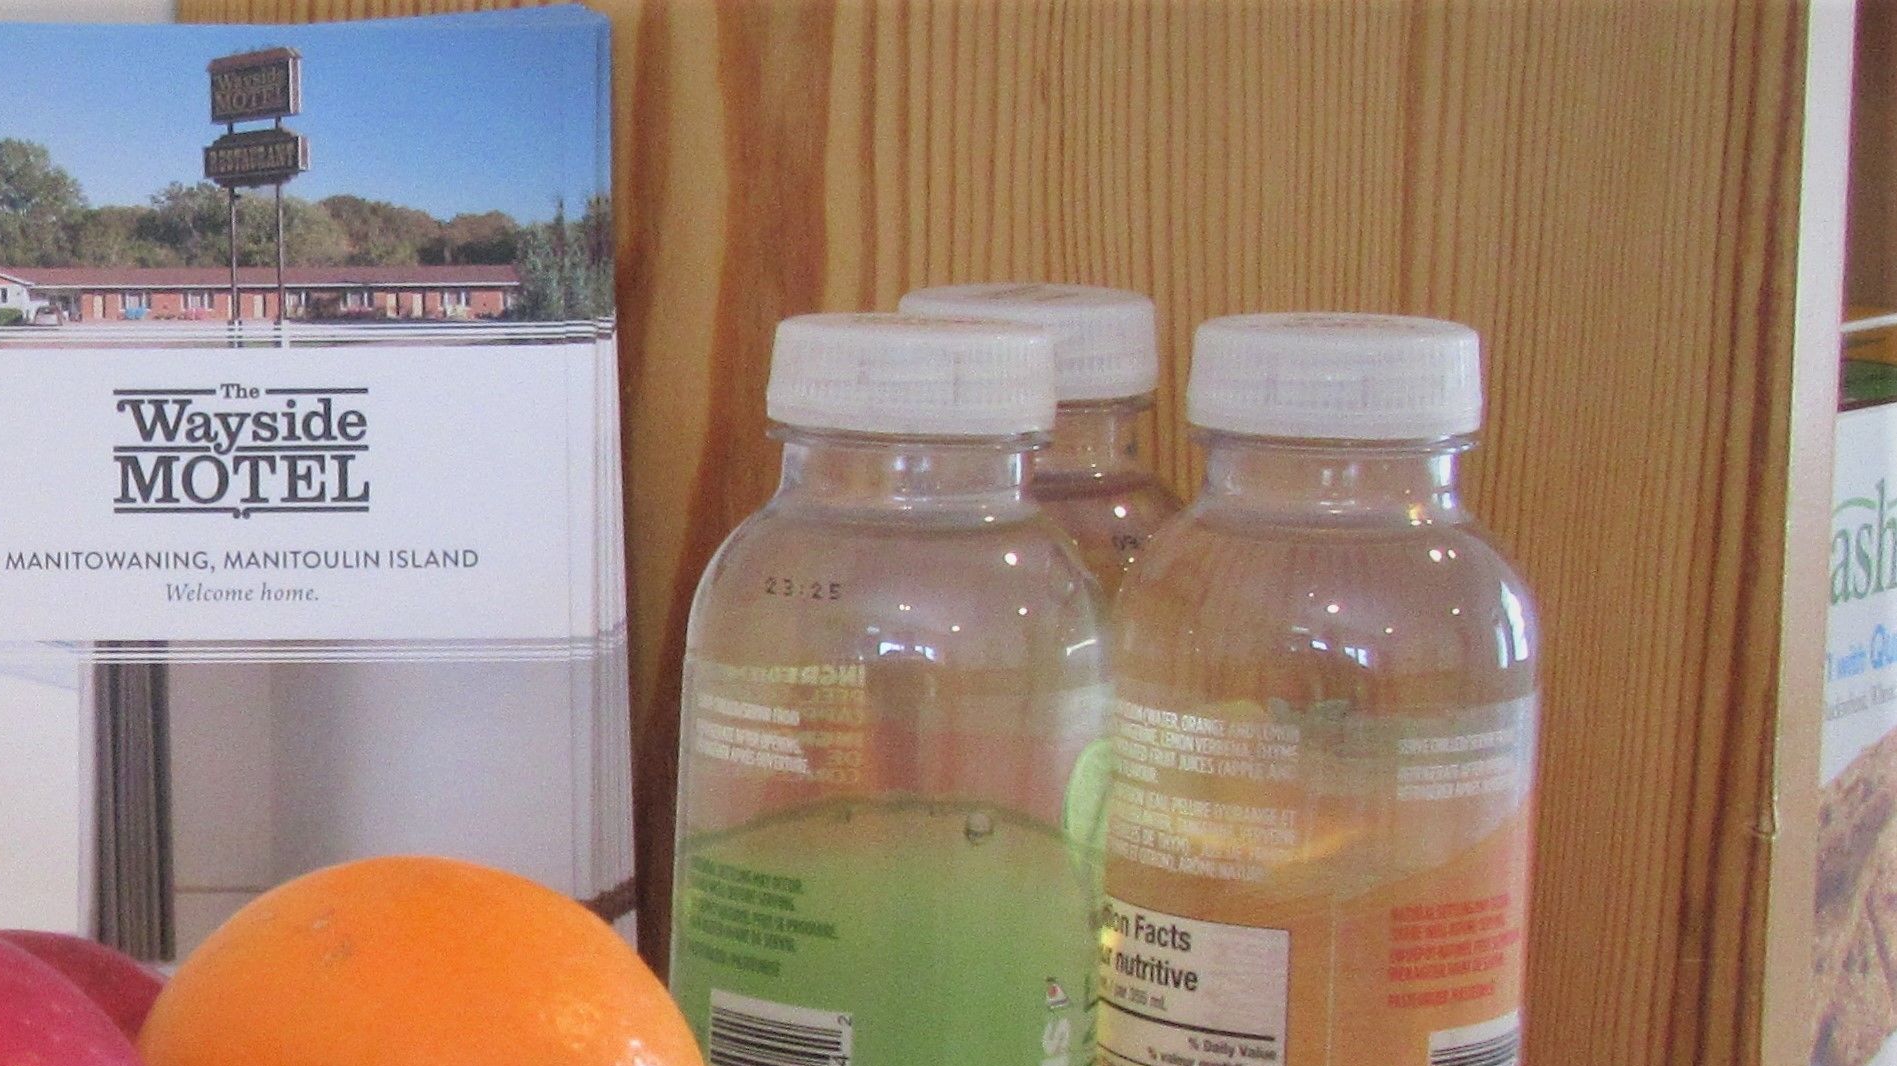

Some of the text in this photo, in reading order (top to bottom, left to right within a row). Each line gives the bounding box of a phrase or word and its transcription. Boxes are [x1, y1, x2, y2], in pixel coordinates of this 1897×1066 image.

[220, 384, 259, 399] The
[117, 398, 367, 454] Wayside
[113, 454, 369, 504] MOTEL
[5, 549, 479, 573] MANITOWANING, MANITOULIN ISLAND
[165, 582, 320, 602] Welcome home.
[765, 576, 842, 601] 23:25
[1135, 914, 1192, 952] Facts
[1115, 952, 1199, 992] nutritive
[836, 1014, 853, 1028] 2
[1203, 1039, 1235, 1058] Daily
[1237, 1045, 1277, 1060] Value
